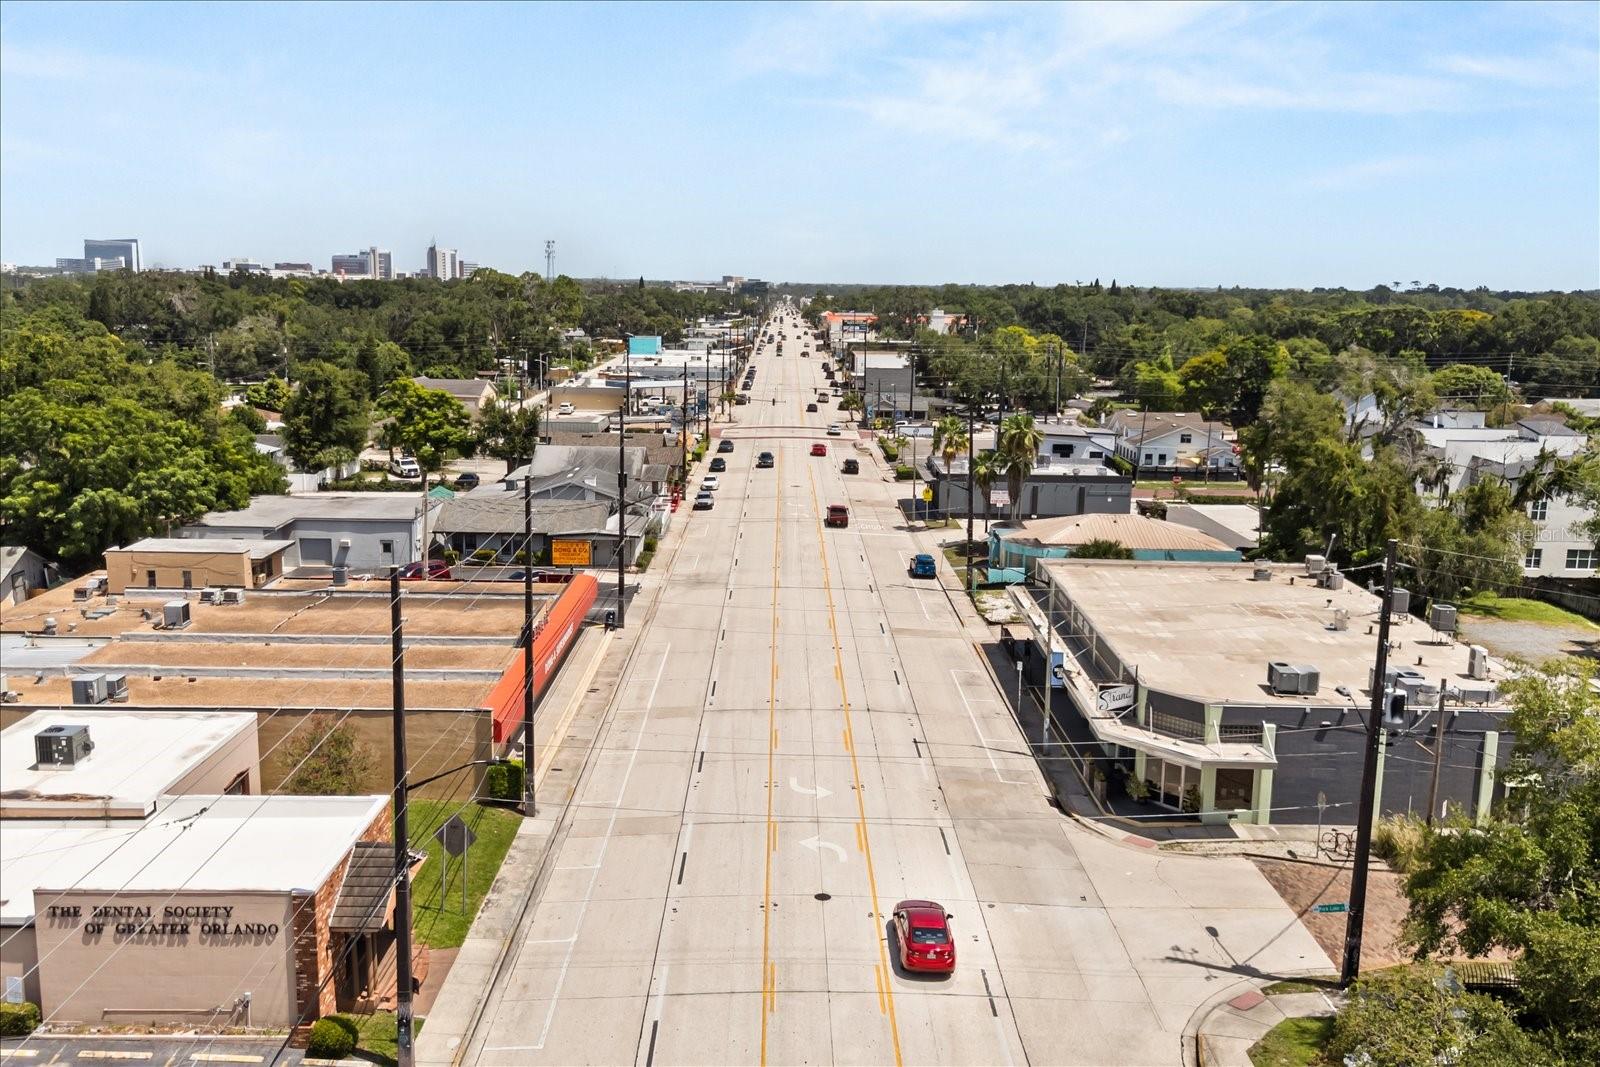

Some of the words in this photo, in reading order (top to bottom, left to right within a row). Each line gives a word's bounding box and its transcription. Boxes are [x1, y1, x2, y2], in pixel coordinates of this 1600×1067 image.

[1099, 688, 1132, 710] Strand
[48, 906, 82, 918] THE
[93, 906, 154, 918] DENTAL
[164, 906, 234, 918] SOCIETY
[84, 924, 105, 935] OF
[115, 924, 190, 935] GREATER
[200, 923, 279, 935] ORLANDO
